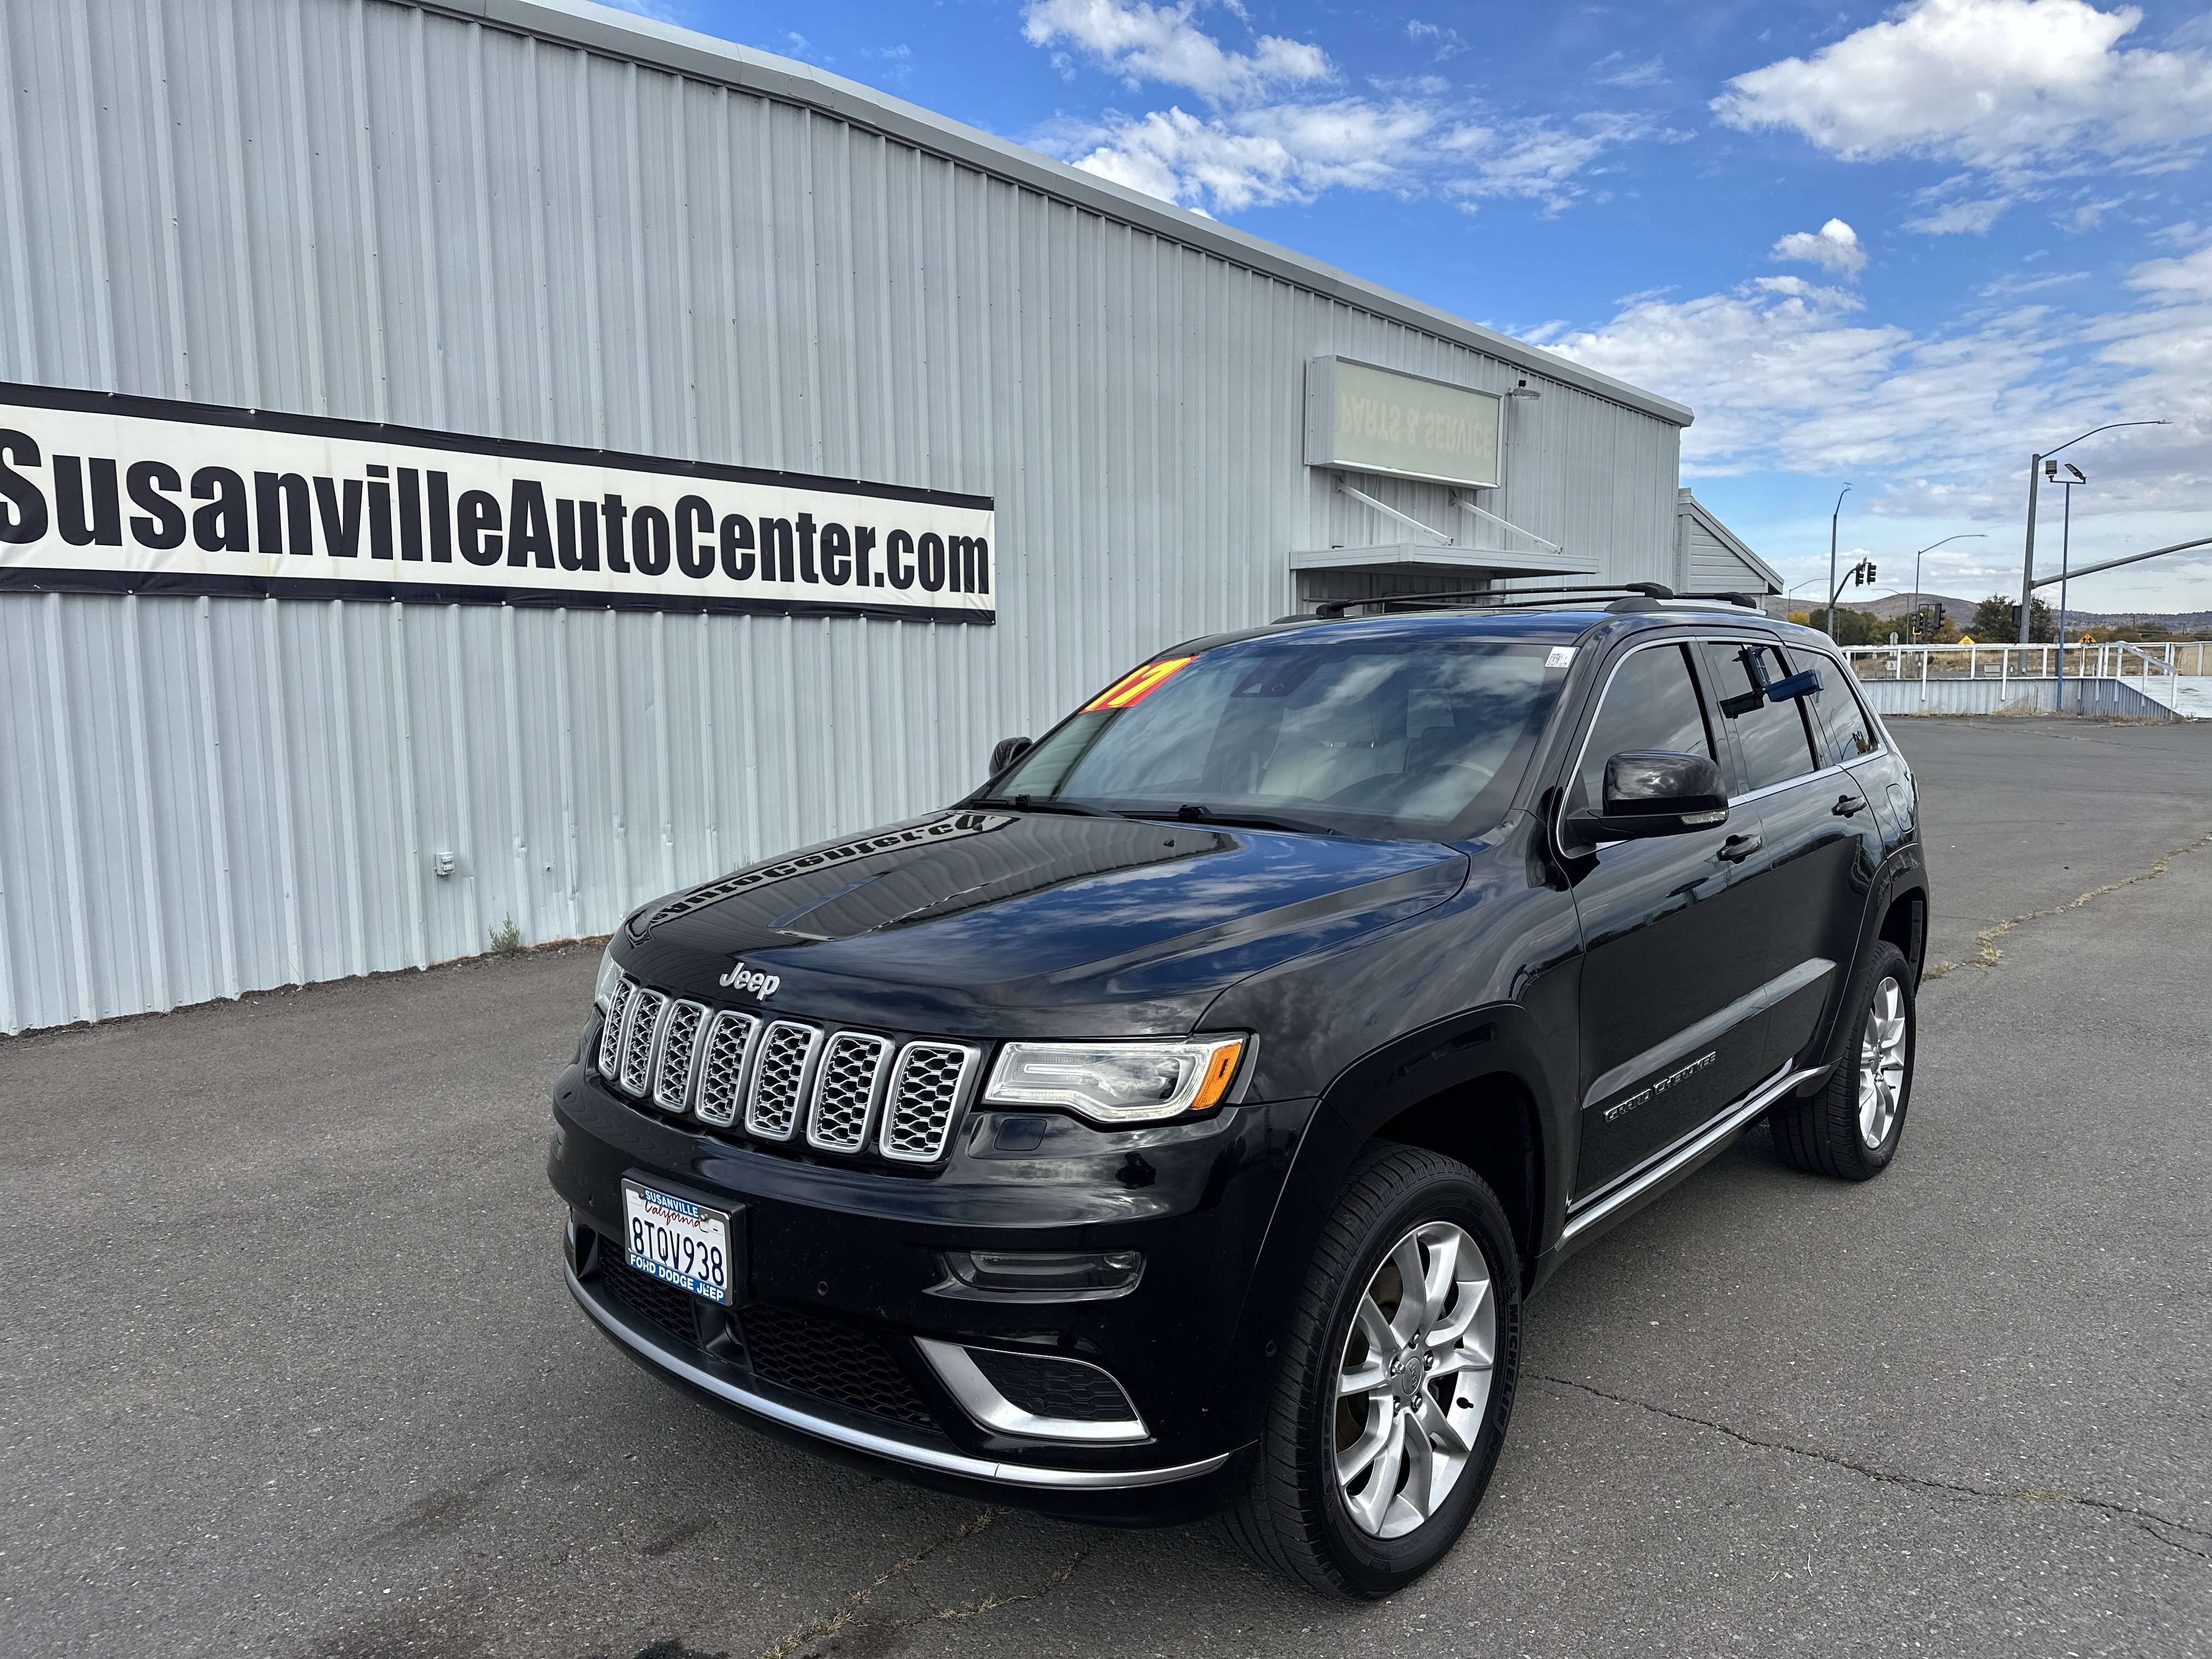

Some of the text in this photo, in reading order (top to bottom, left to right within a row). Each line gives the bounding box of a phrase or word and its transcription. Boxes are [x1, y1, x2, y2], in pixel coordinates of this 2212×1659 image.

[0, 428, 989, 595] SusanvilleAutoCenter.com
[1085, 657, 1191, 711] 17
[719, 962, 781, 1001] Jeep
[645, 1190, 699, 1217] SUSANVILLE
[630, 1254, 724, 1301] FORD DODGE JEEP
[633, 1217, 724, 1286] 8TQV938
[1497, 1304, 1519, 1427] MICHELIN
